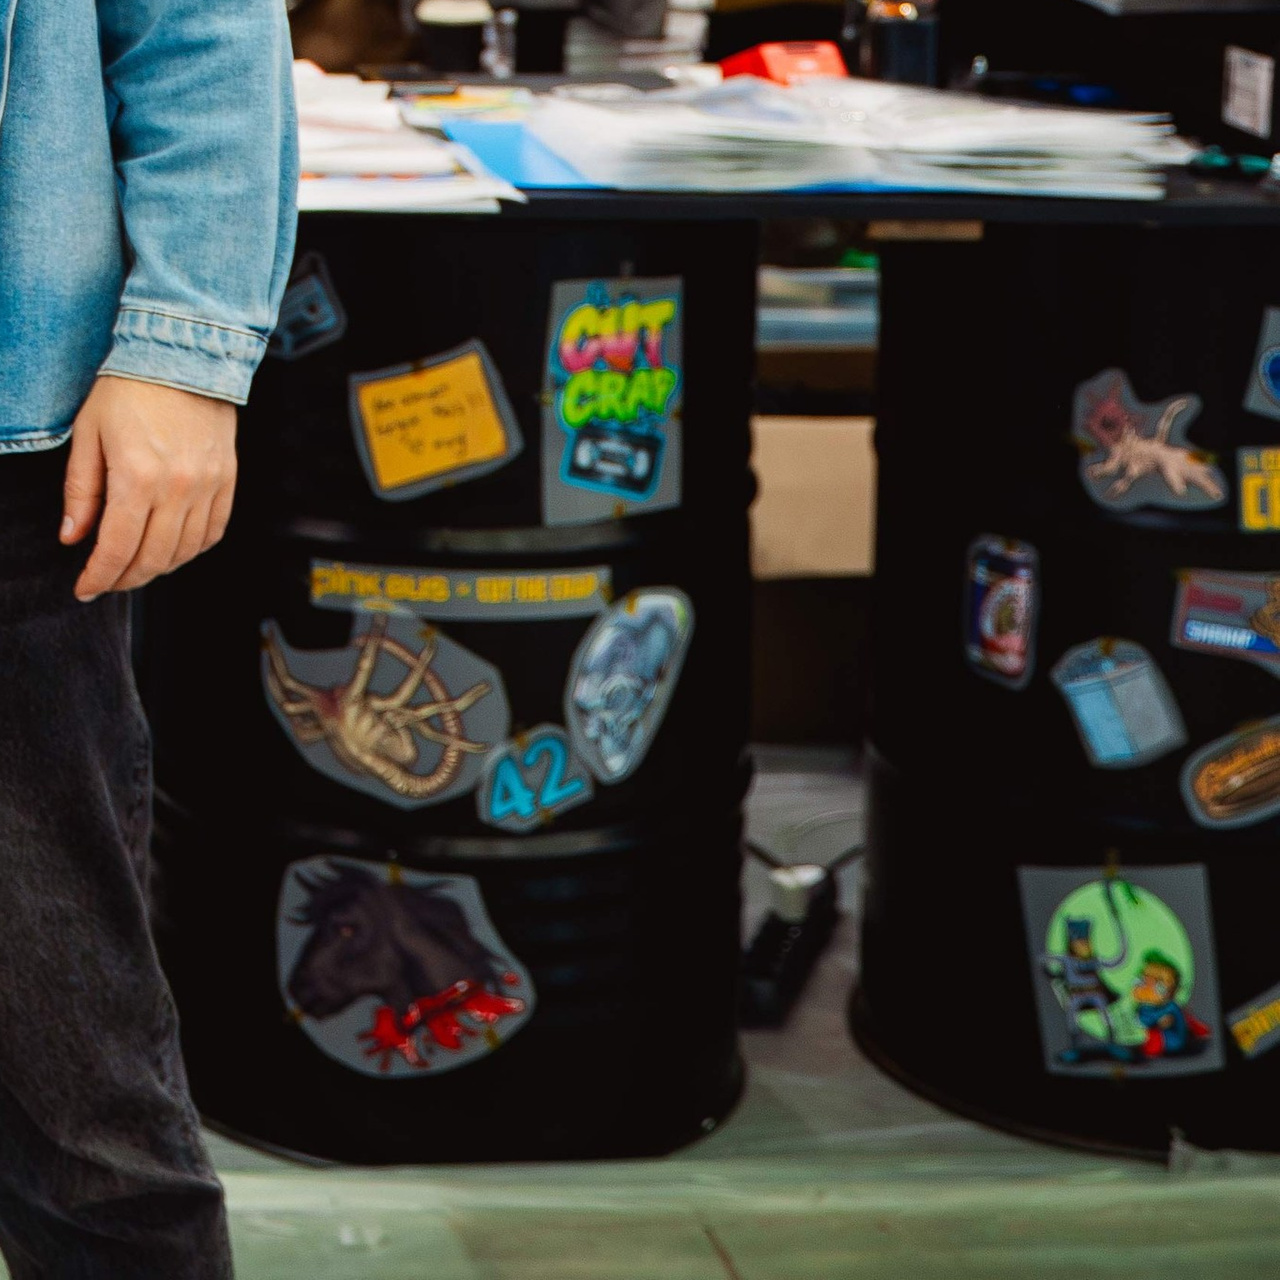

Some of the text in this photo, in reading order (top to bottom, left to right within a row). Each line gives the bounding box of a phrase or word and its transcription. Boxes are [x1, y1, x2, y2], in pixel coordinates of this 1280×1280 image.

[559, 300, 677, 374] CUT
[562, 368, 678, 428] CRAP
[489, 737, 586, 820] 42
